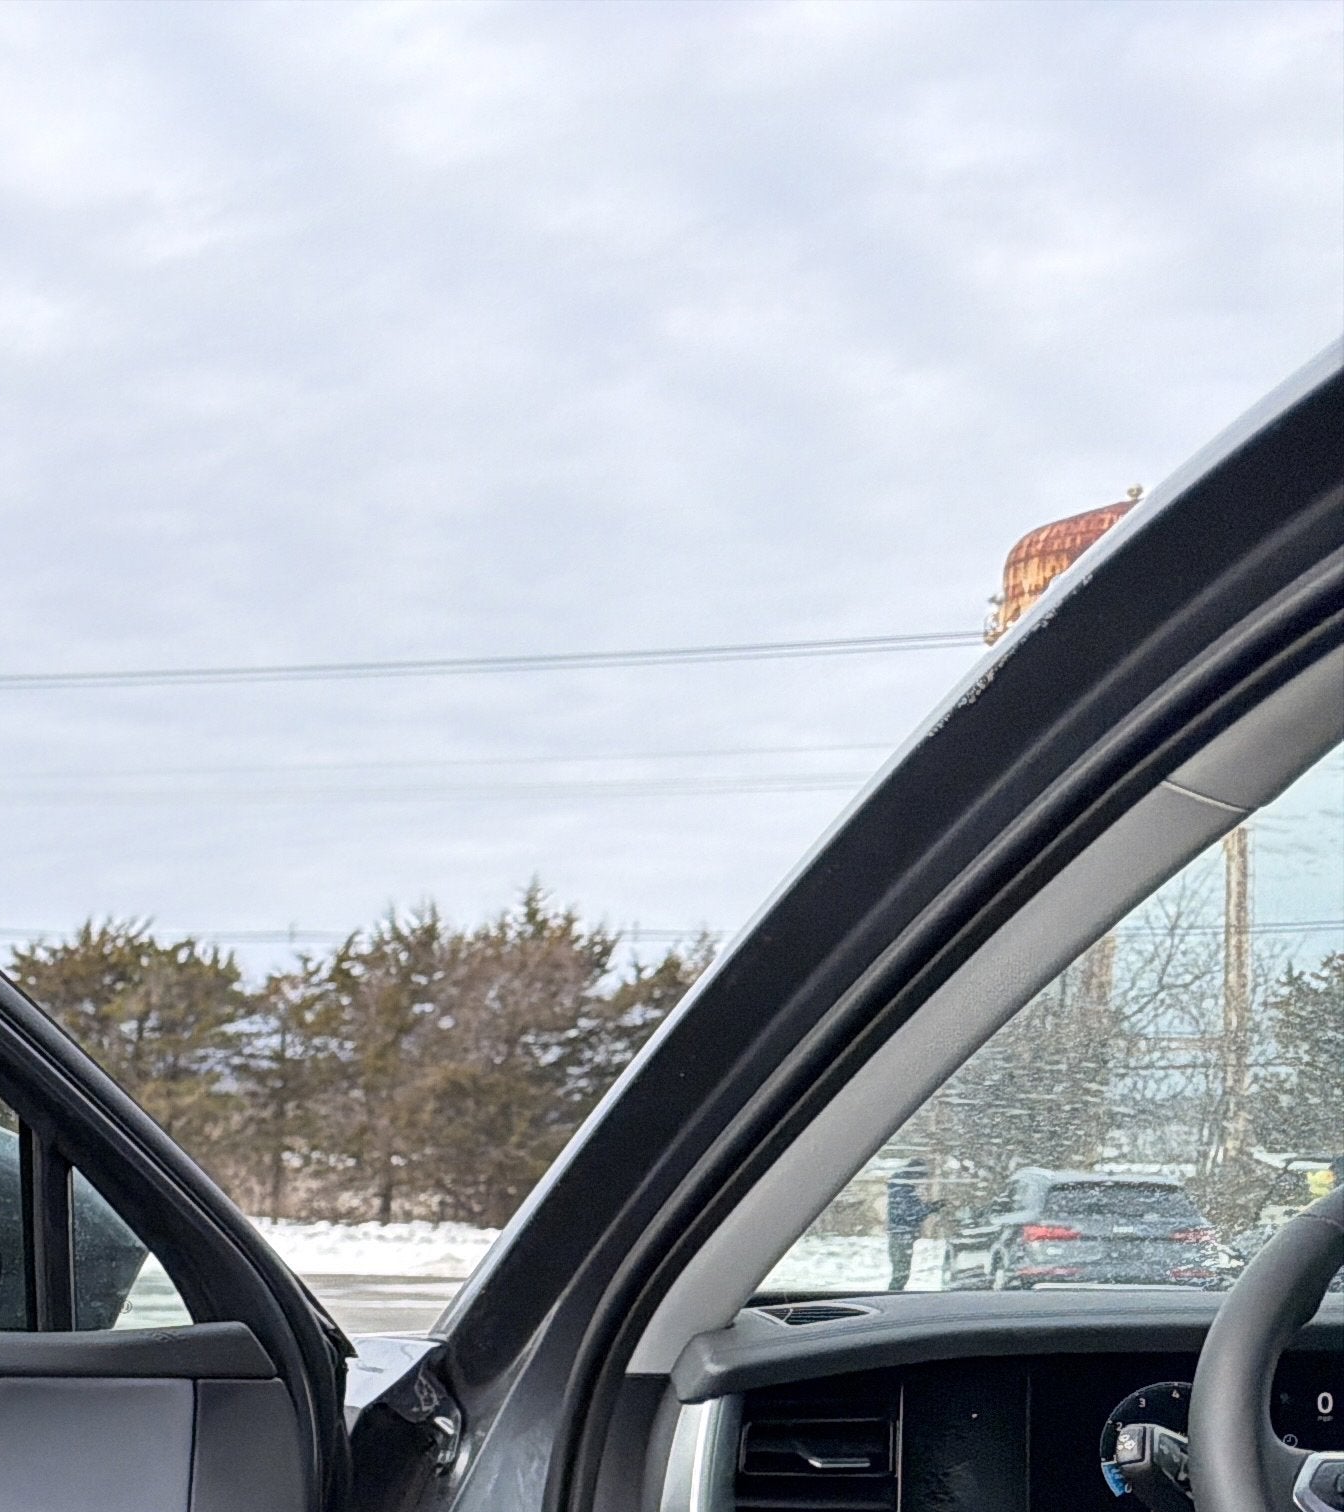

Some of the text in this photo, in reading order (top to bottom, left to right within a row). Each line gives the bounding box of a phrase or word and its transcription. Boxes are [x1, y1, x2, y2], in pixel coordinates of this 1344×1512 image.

[1171, 1390, 1180, 1399] 4
[1138, 1398, 1146, 1408] 3
[1317, 1391, 1334, 1414] 0
[1115, 1421, 1123, 1432] 2
